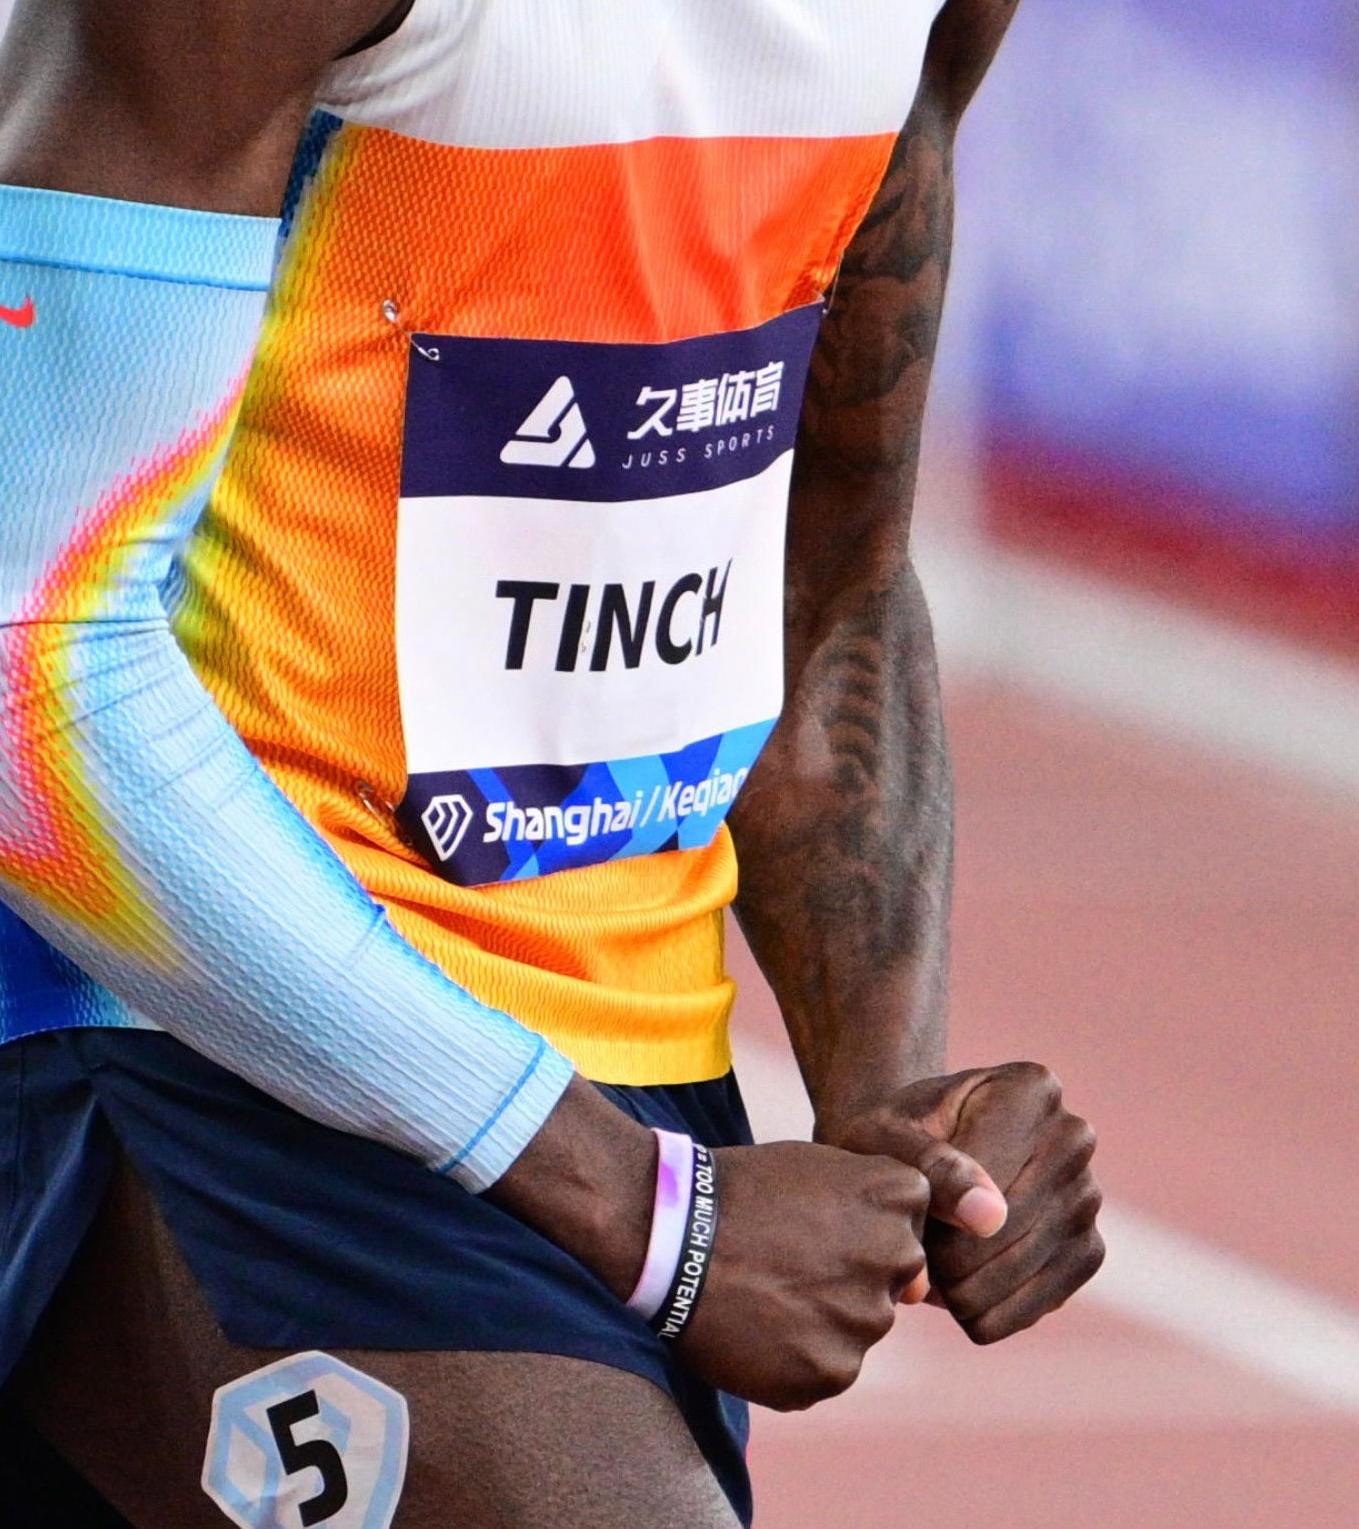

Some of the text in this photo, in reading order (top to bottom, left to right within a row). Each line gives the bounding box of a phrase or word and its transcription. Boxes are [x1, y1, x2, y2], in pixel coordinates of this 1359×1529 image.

[626, 361, 784, 440] 久事体育
[622, 425, 774, 469] JUSS SPORTS
[494, 557, 733, 672] TINCH
[695, 1163, 714, 1194] TOO
[689, 1195, 716, 1248] MUCH
[657, 1248, 706, 1338] POTENTIAL
[266, 1389, 348, 1527] 5
